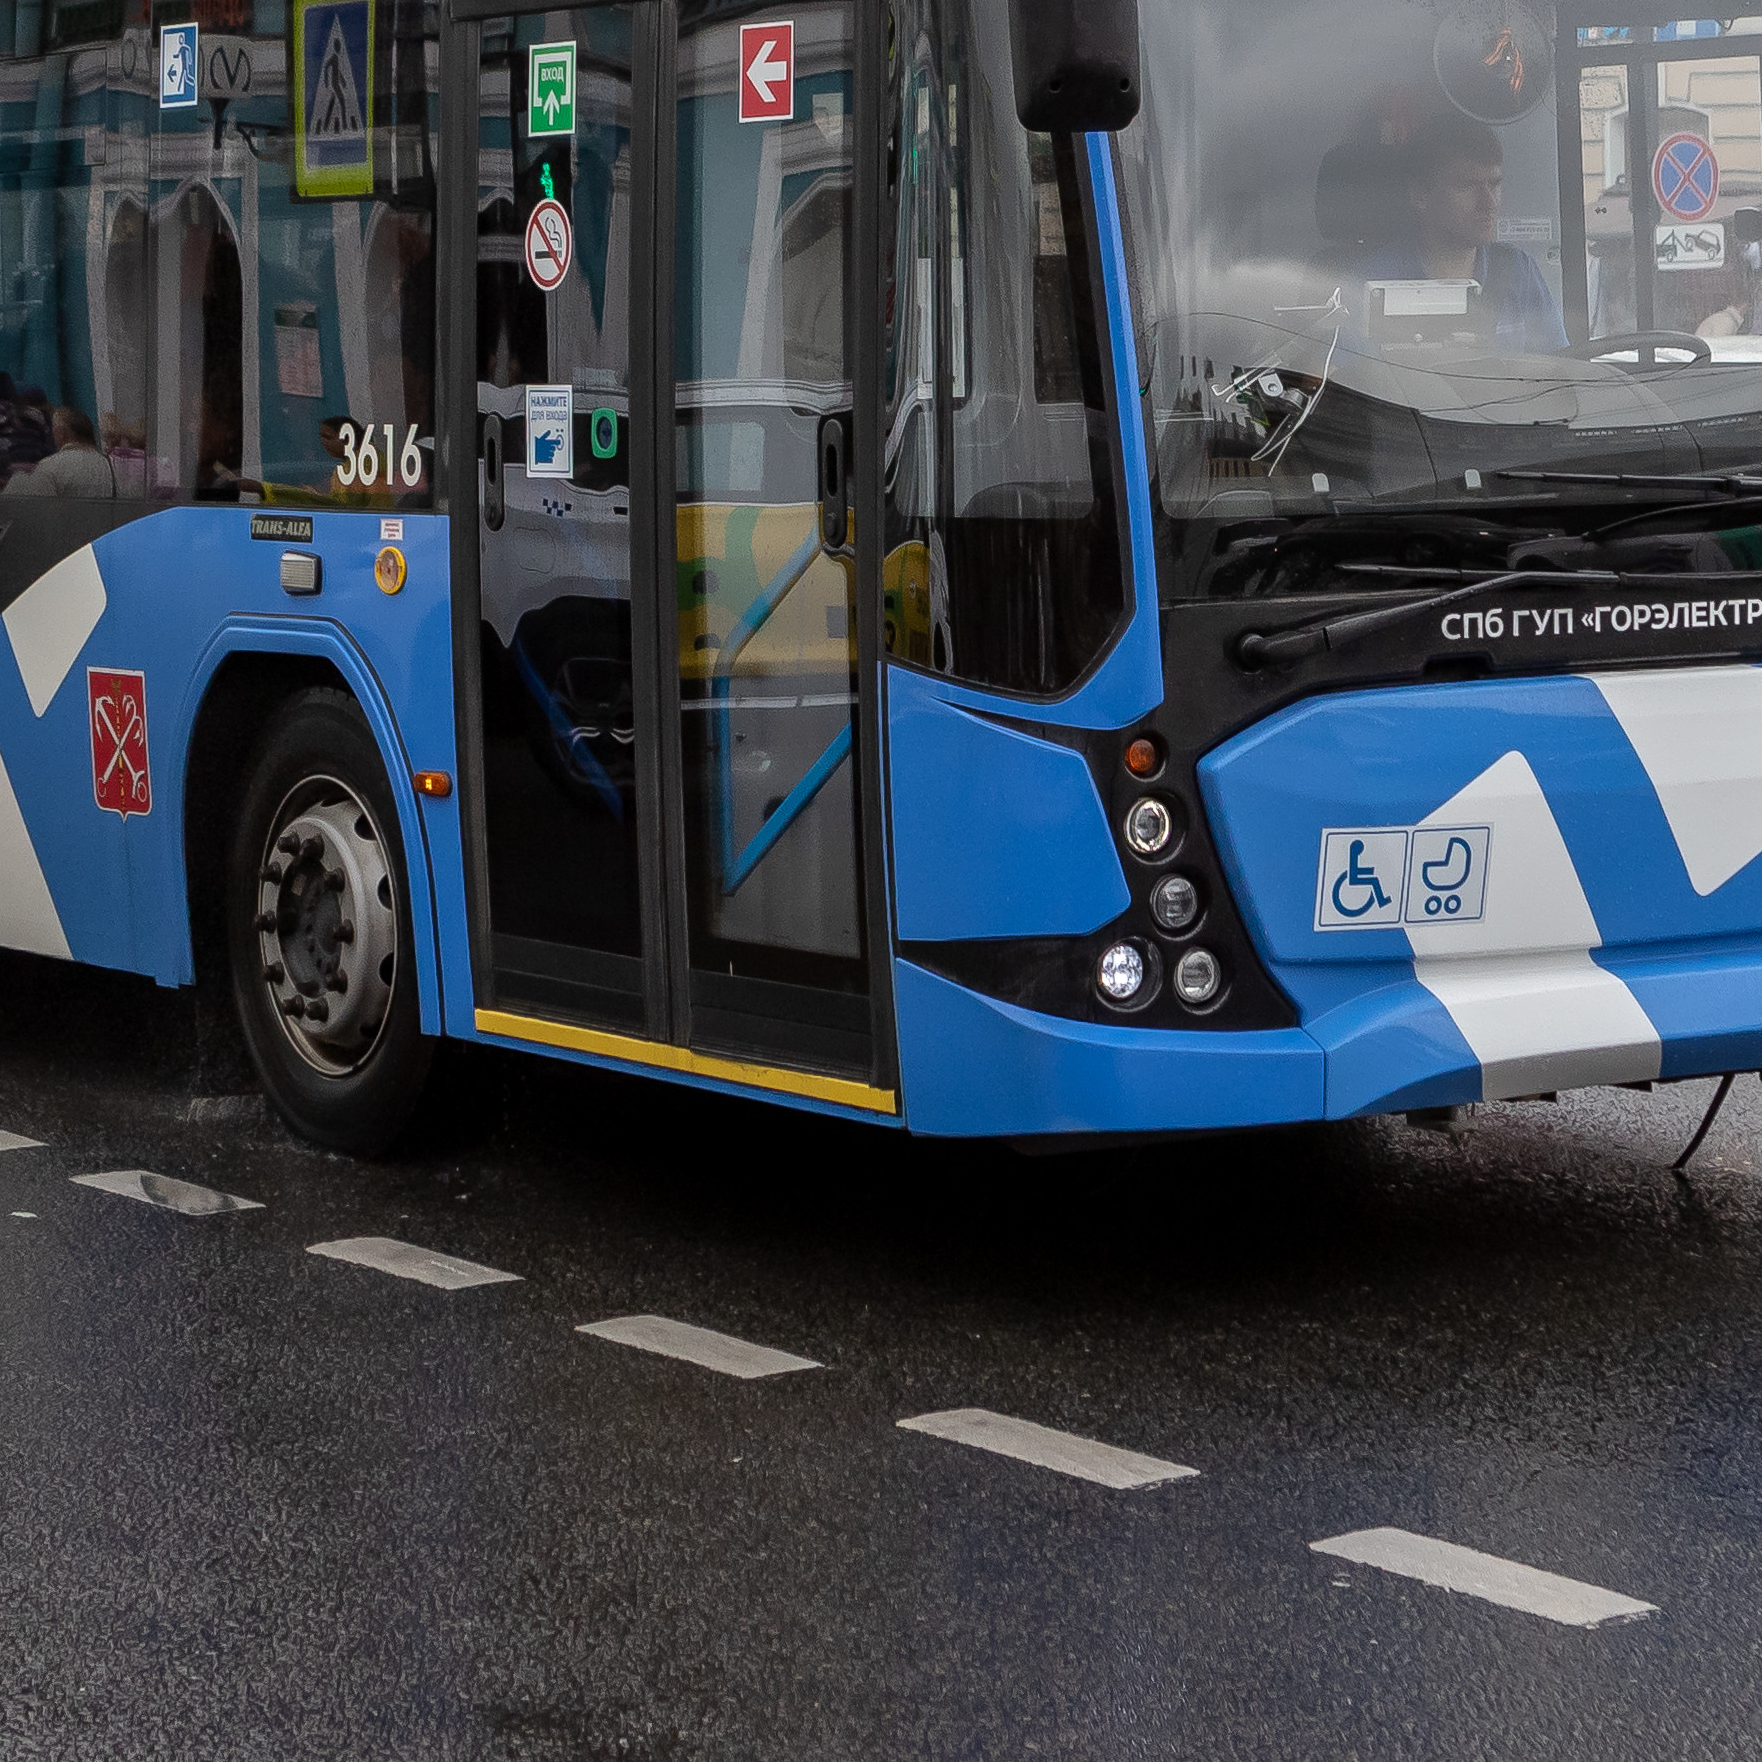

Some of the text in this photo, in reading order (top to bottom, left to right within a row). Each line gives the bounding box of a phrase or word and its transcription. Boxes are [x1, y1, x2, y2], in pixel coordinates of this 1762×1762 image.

[540, 66, 564, 82] ВХОД
[531, 396, 567, 407] НАЖМИТЕ
[336, 422, 422, 487] 3616
[1441, 607, 1504, 640] СПб
[1512, 608, 1574, 638] ГУП
